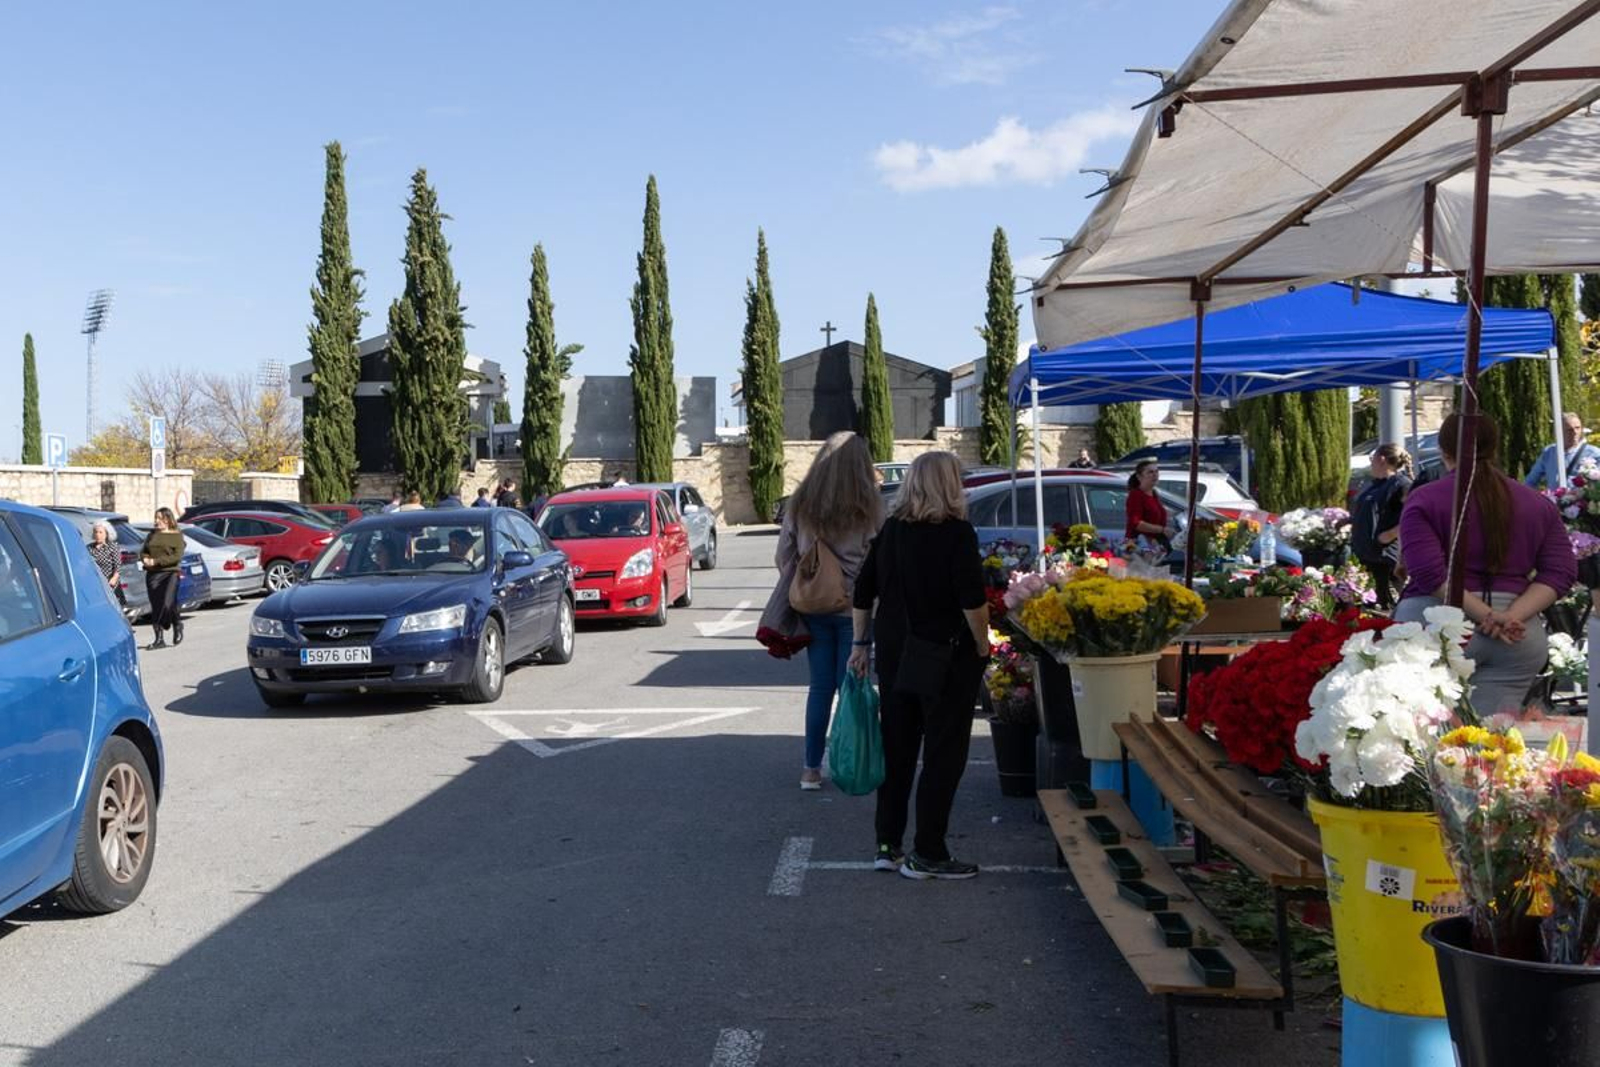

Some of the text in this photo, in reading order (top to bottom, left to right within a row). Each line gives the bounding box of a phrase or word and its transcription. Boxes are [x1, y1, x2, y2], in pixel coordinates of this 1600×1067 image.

[50, 437, 64, 465] P
[308, 648, 369, 662] 5976 GFN
